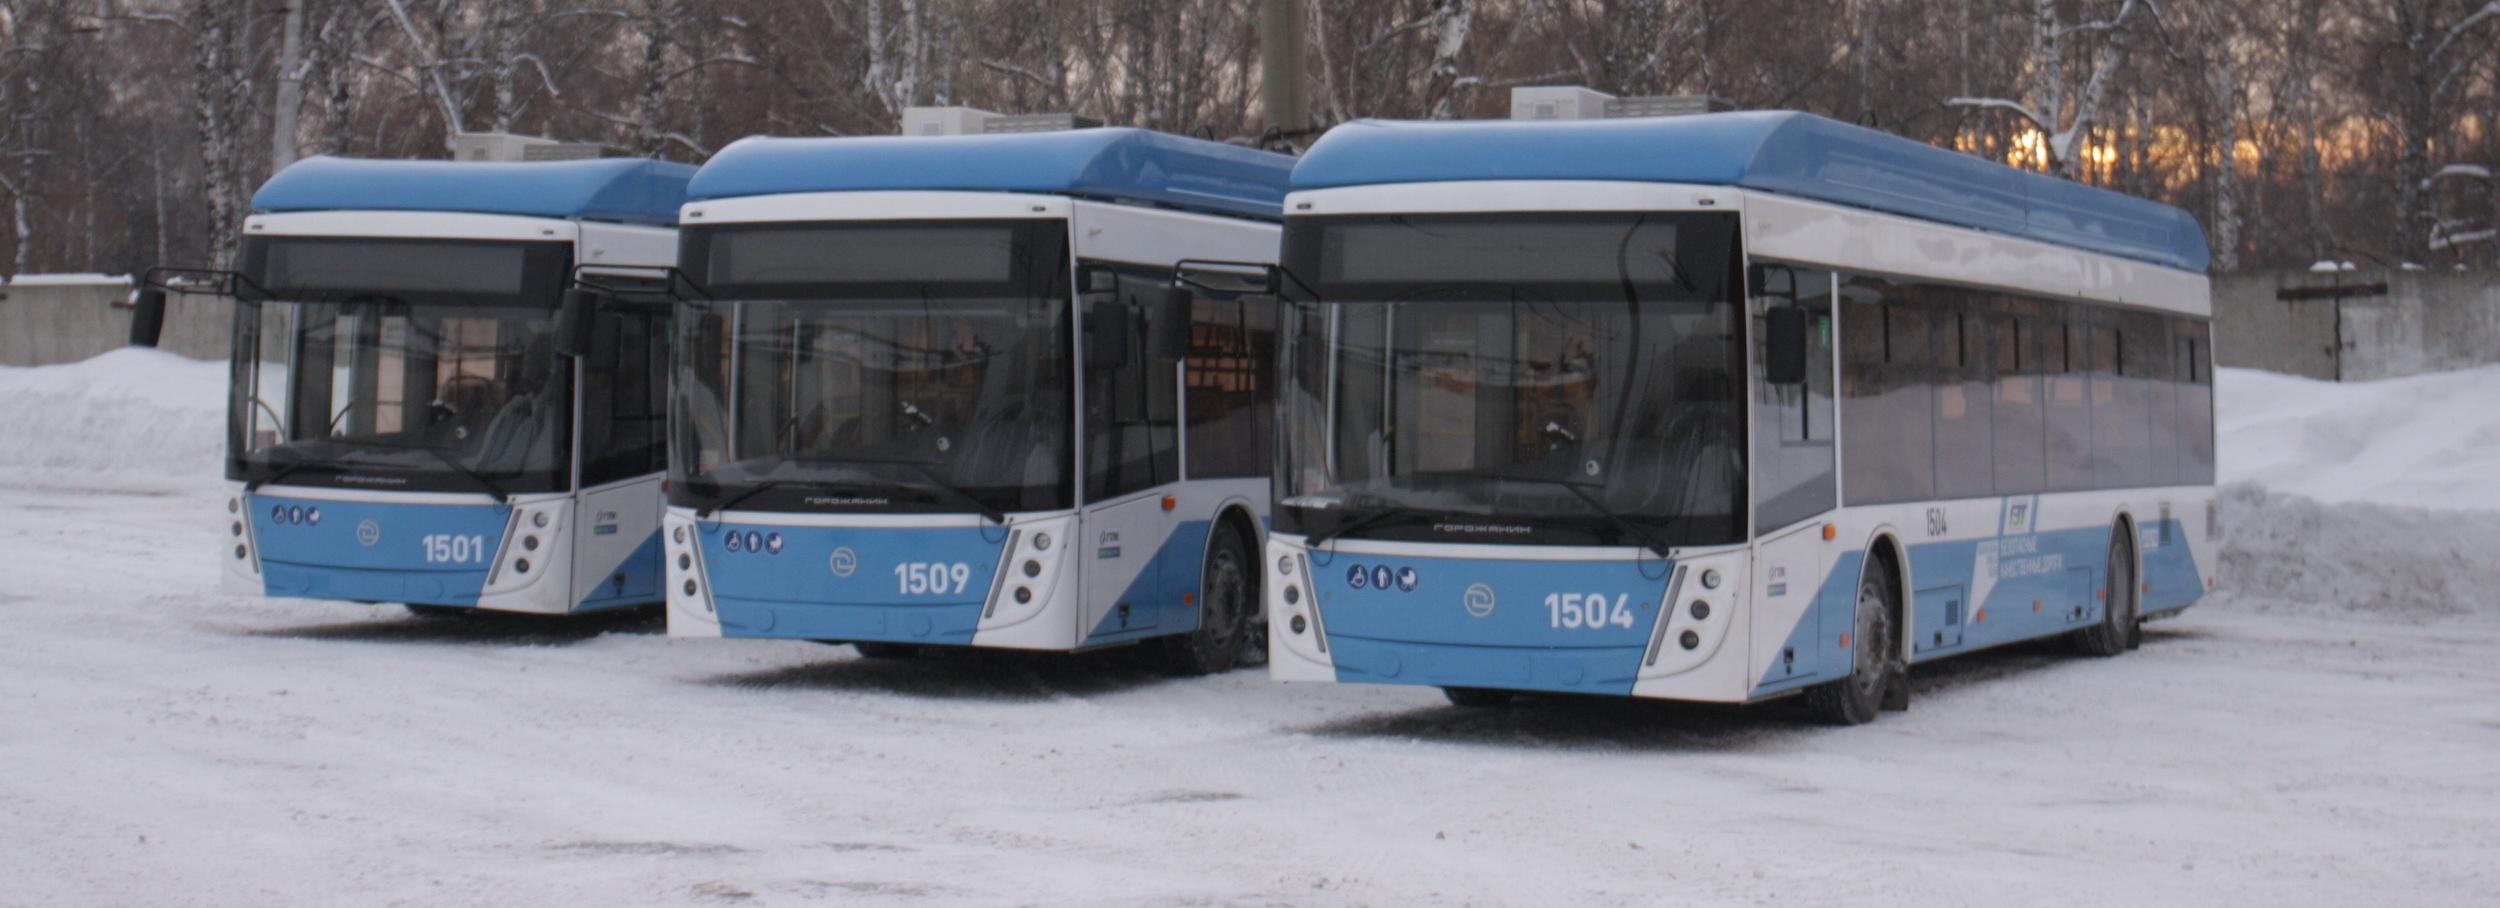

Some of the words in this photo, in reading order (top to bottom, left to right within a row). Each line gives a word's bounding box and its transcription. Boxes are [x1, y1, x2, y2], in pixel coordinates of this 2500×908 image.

[804, 496, 888, 505] ГОРОЖАНИН
[1433, 523, 1531, 534] ГОРОЖАНИН
[1926, 506, 1947, 537] 1504
[422, 534, 483, 563] 1501
[894, 562, 970, 595] 1509
[1544, 592, 1633, 629] 1504
